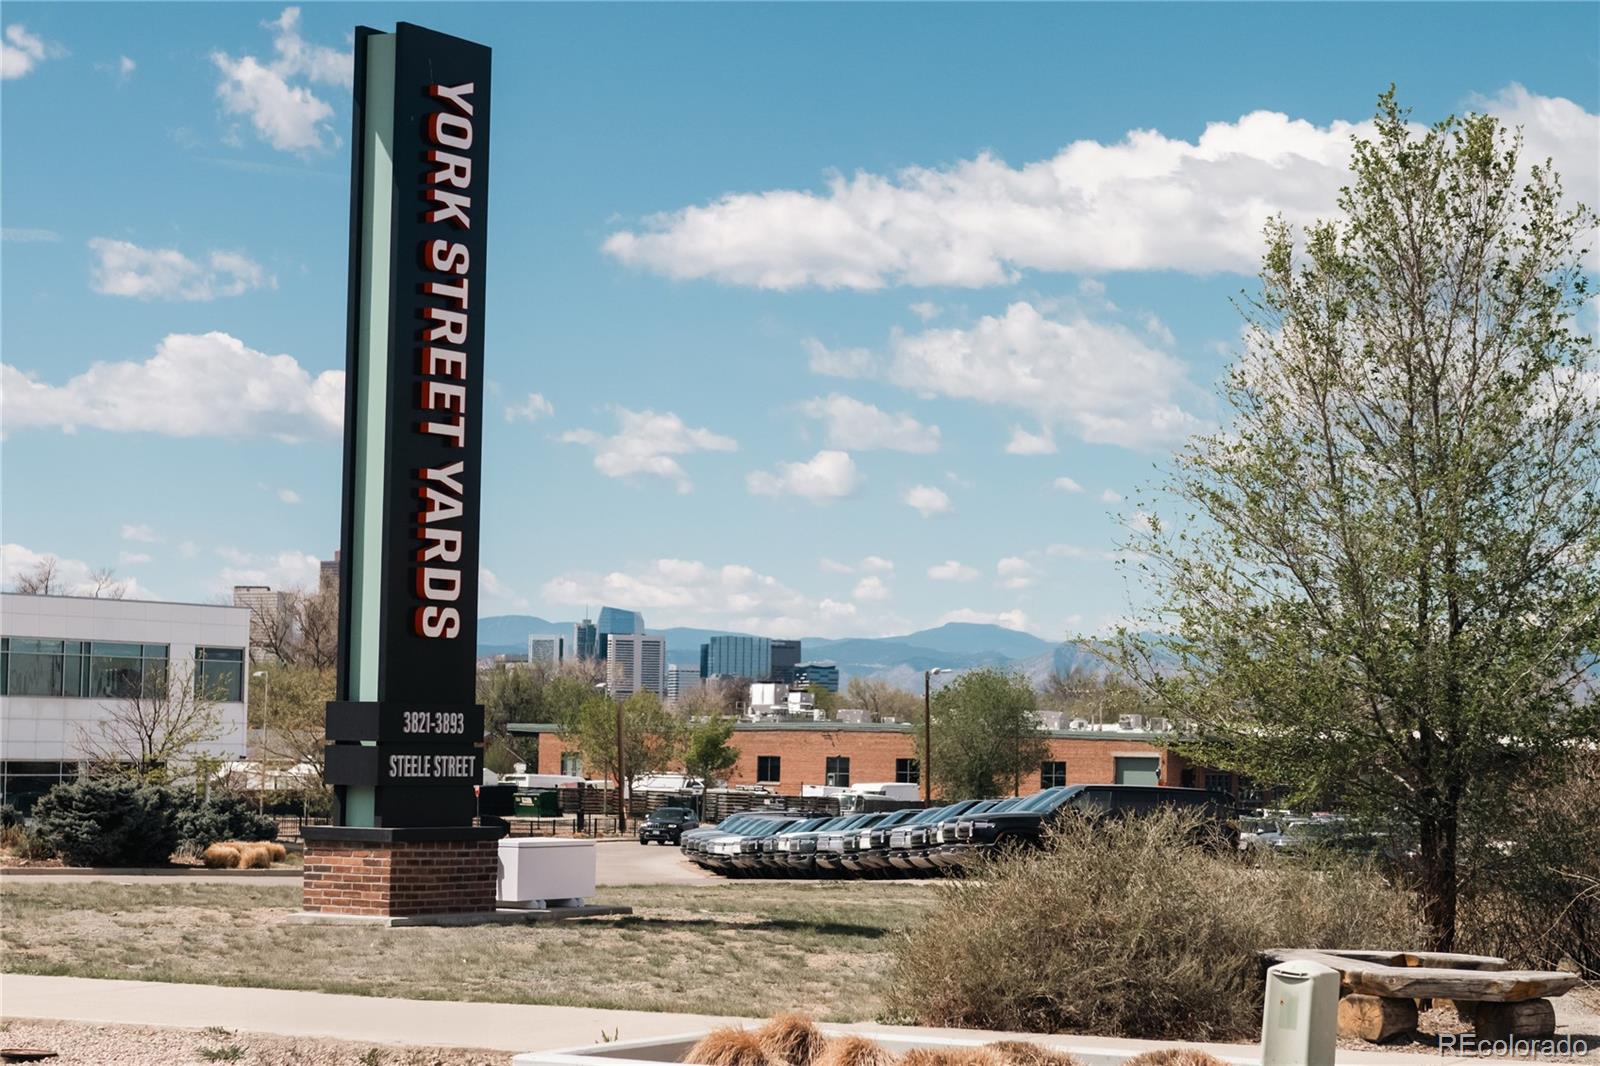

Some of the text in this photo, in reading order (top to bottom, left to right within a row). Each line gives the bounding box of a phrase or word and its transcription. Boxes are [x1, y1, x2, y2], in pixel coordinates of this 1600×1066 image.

[420, 82, 475, 640] YORK STREET YARDS
[403, 711, 464, 734] 3821-3893
[389, 755, 475, 777] STEELE STREET
